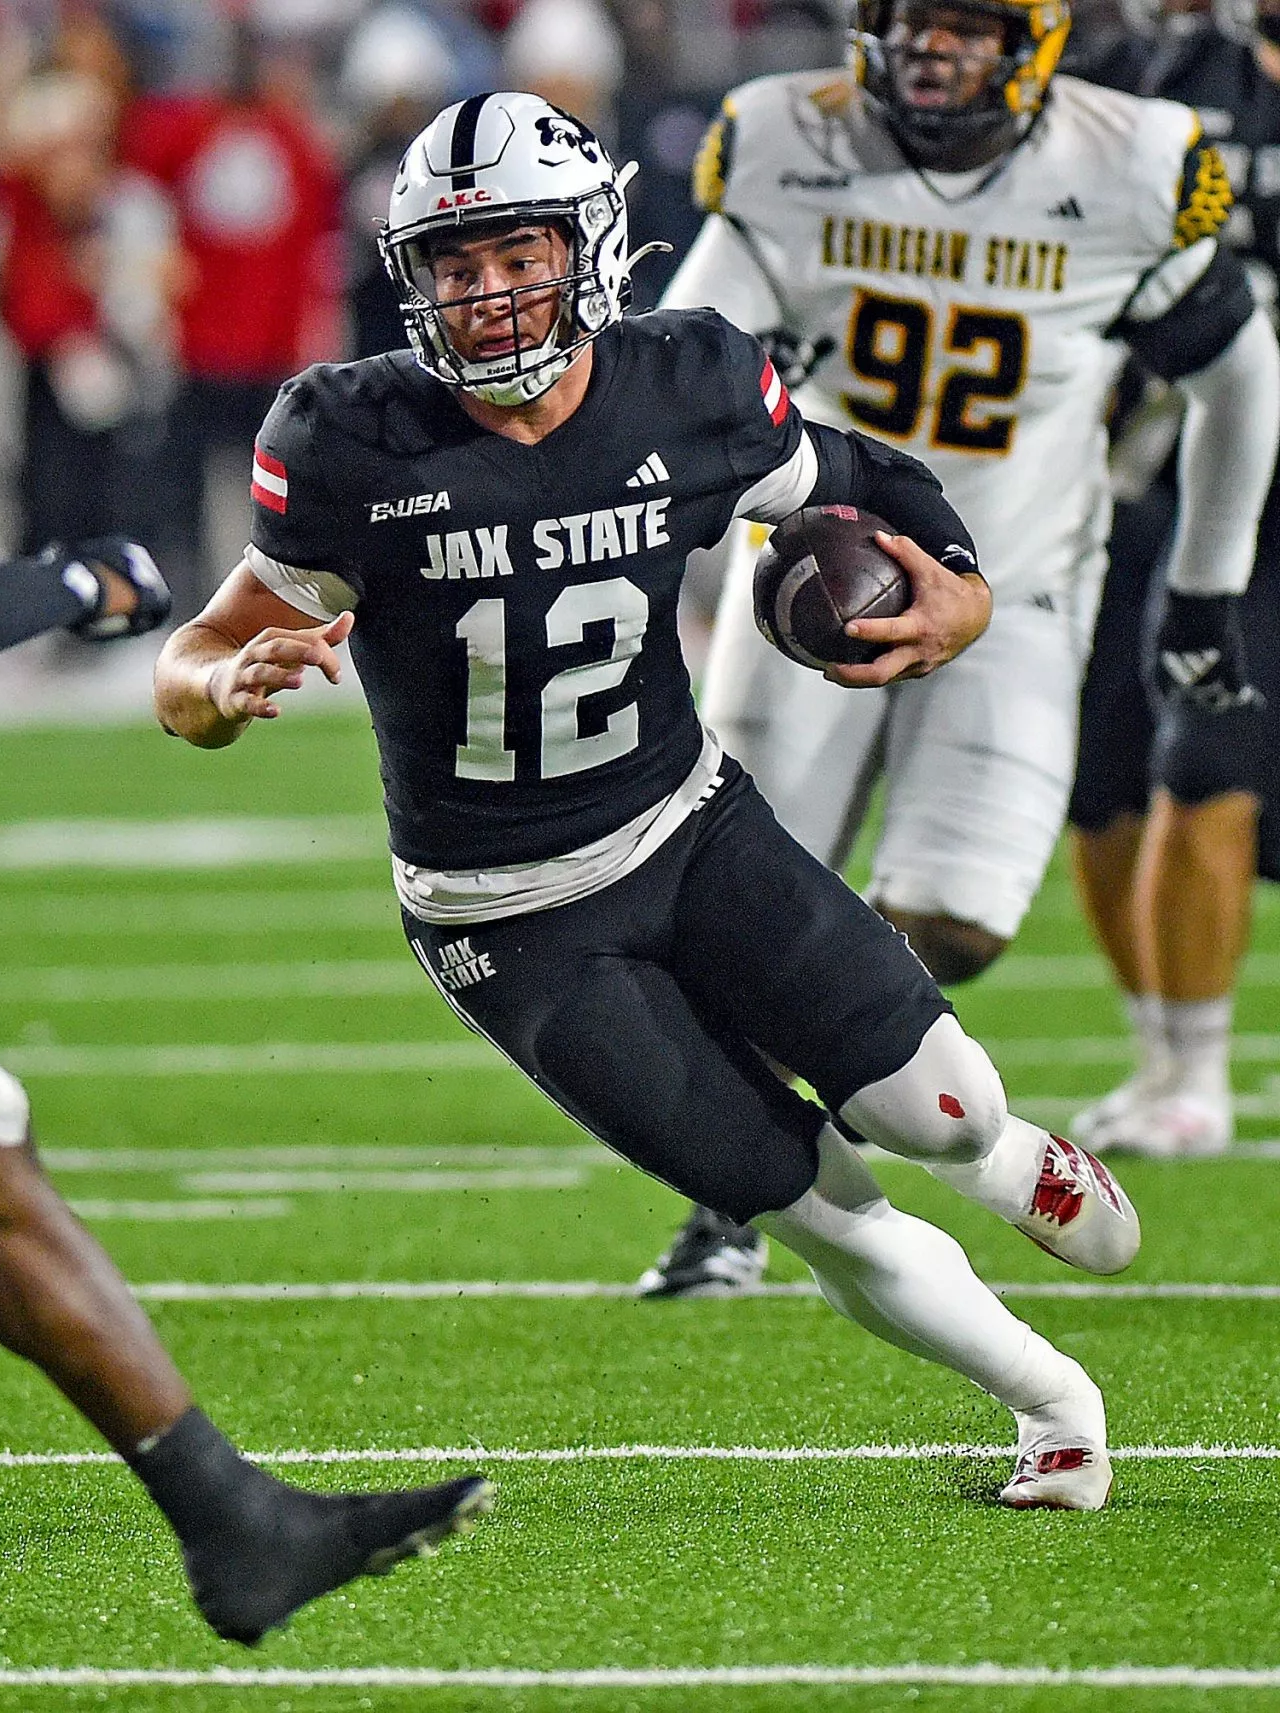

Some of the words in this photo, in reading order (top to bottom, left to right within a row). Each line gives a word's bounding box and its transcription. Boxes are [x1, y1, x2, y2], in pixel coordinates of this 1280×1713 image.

[487, 363, 518, 376] Riddel
[842, 285, 1029, 456] 92
[420, 525, 514, 579] JAX
[532, 497, 672, 570] STATE
[455, 576, 649, 782] 12
[440, 952, 497, 990] STATE
